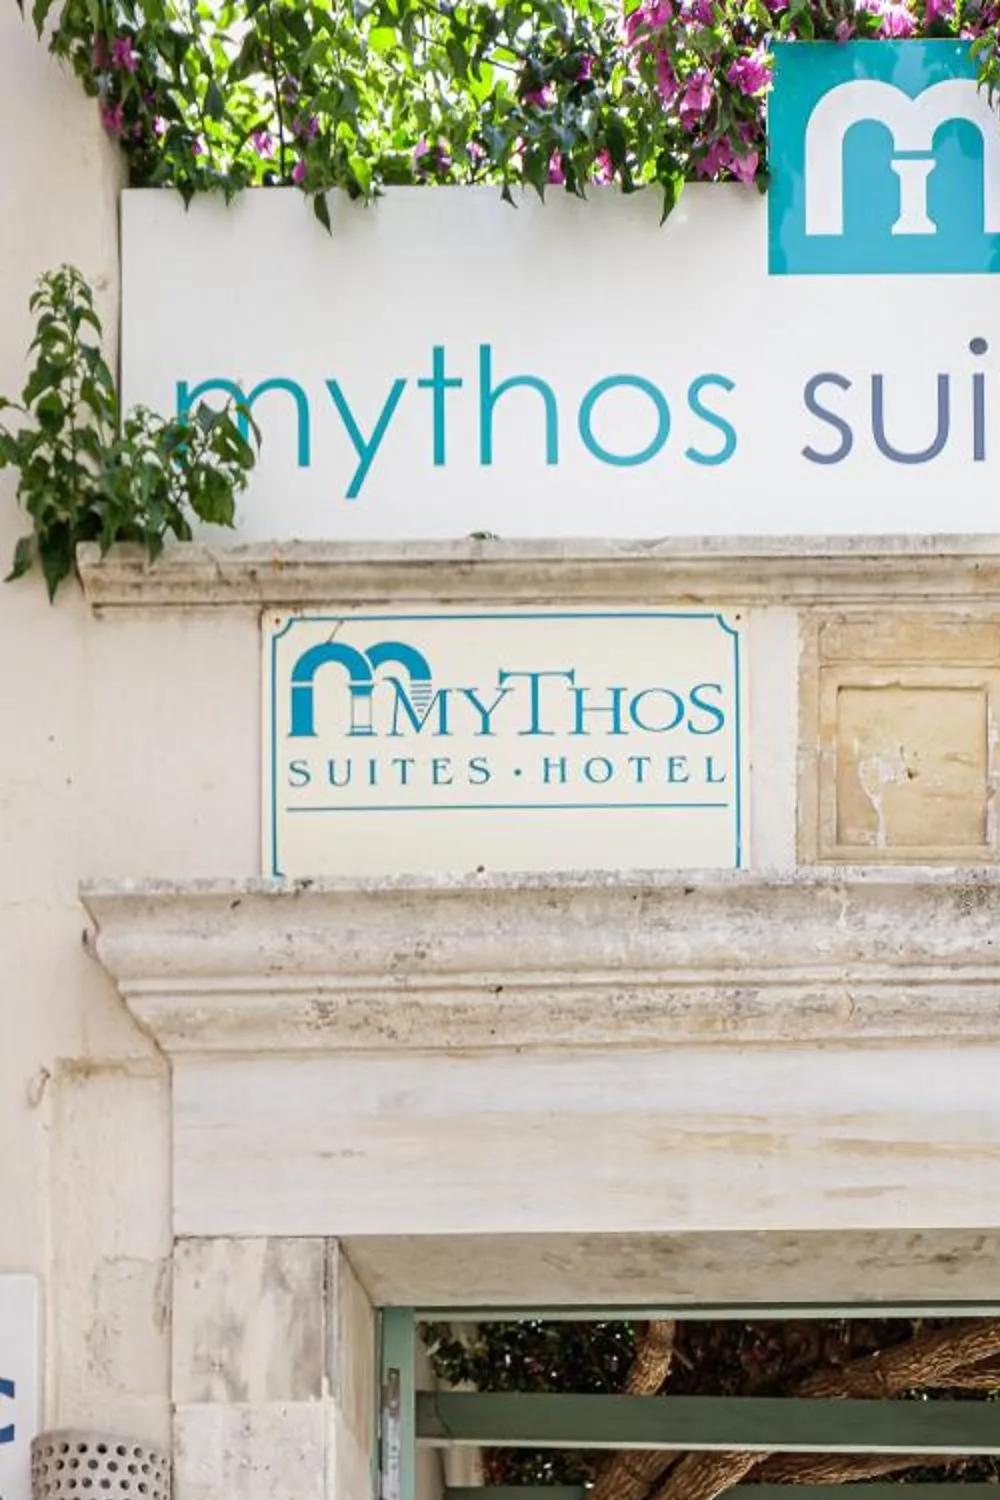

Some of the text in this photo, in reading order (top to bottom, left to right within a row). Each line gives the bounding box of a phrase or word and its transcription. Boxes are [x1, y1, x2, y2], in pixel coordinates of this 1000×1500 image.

[174, 344, 737, 500] mythos
[288, 755, 727, 787] SUITES HOTEL
